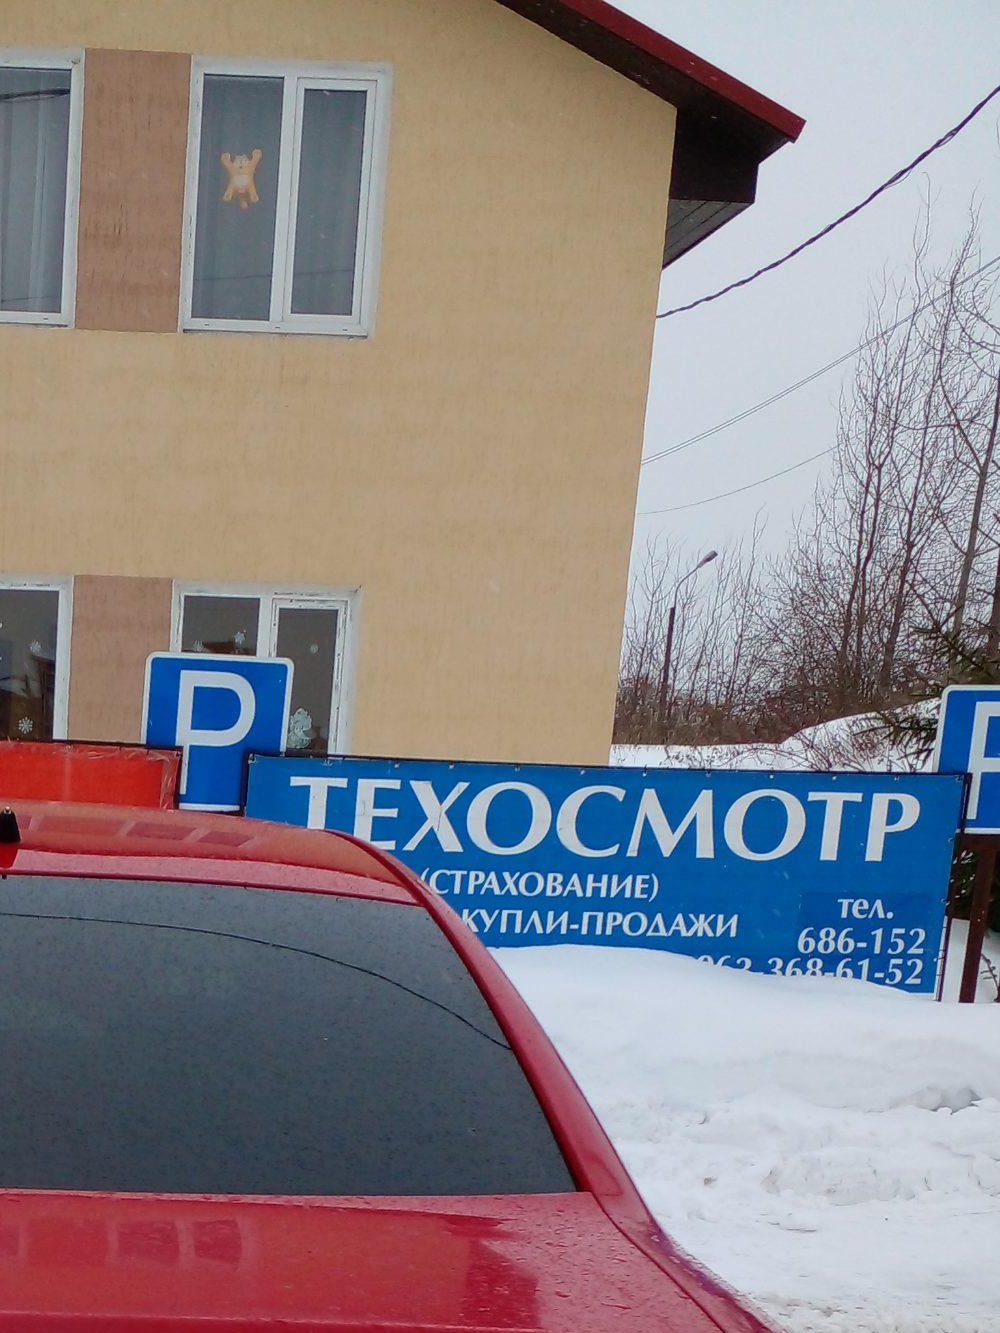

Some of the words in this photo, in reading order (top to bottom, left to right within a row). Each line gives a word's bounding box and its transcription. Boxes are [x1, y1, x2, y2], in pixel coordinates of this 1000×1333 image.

[174, 670, 256, 795] P
[289, 775, 921, 862] ТЕХОСМОТР
[837, 898, 895, 920] тел.
[797, 927, 927, 954] 686-152
